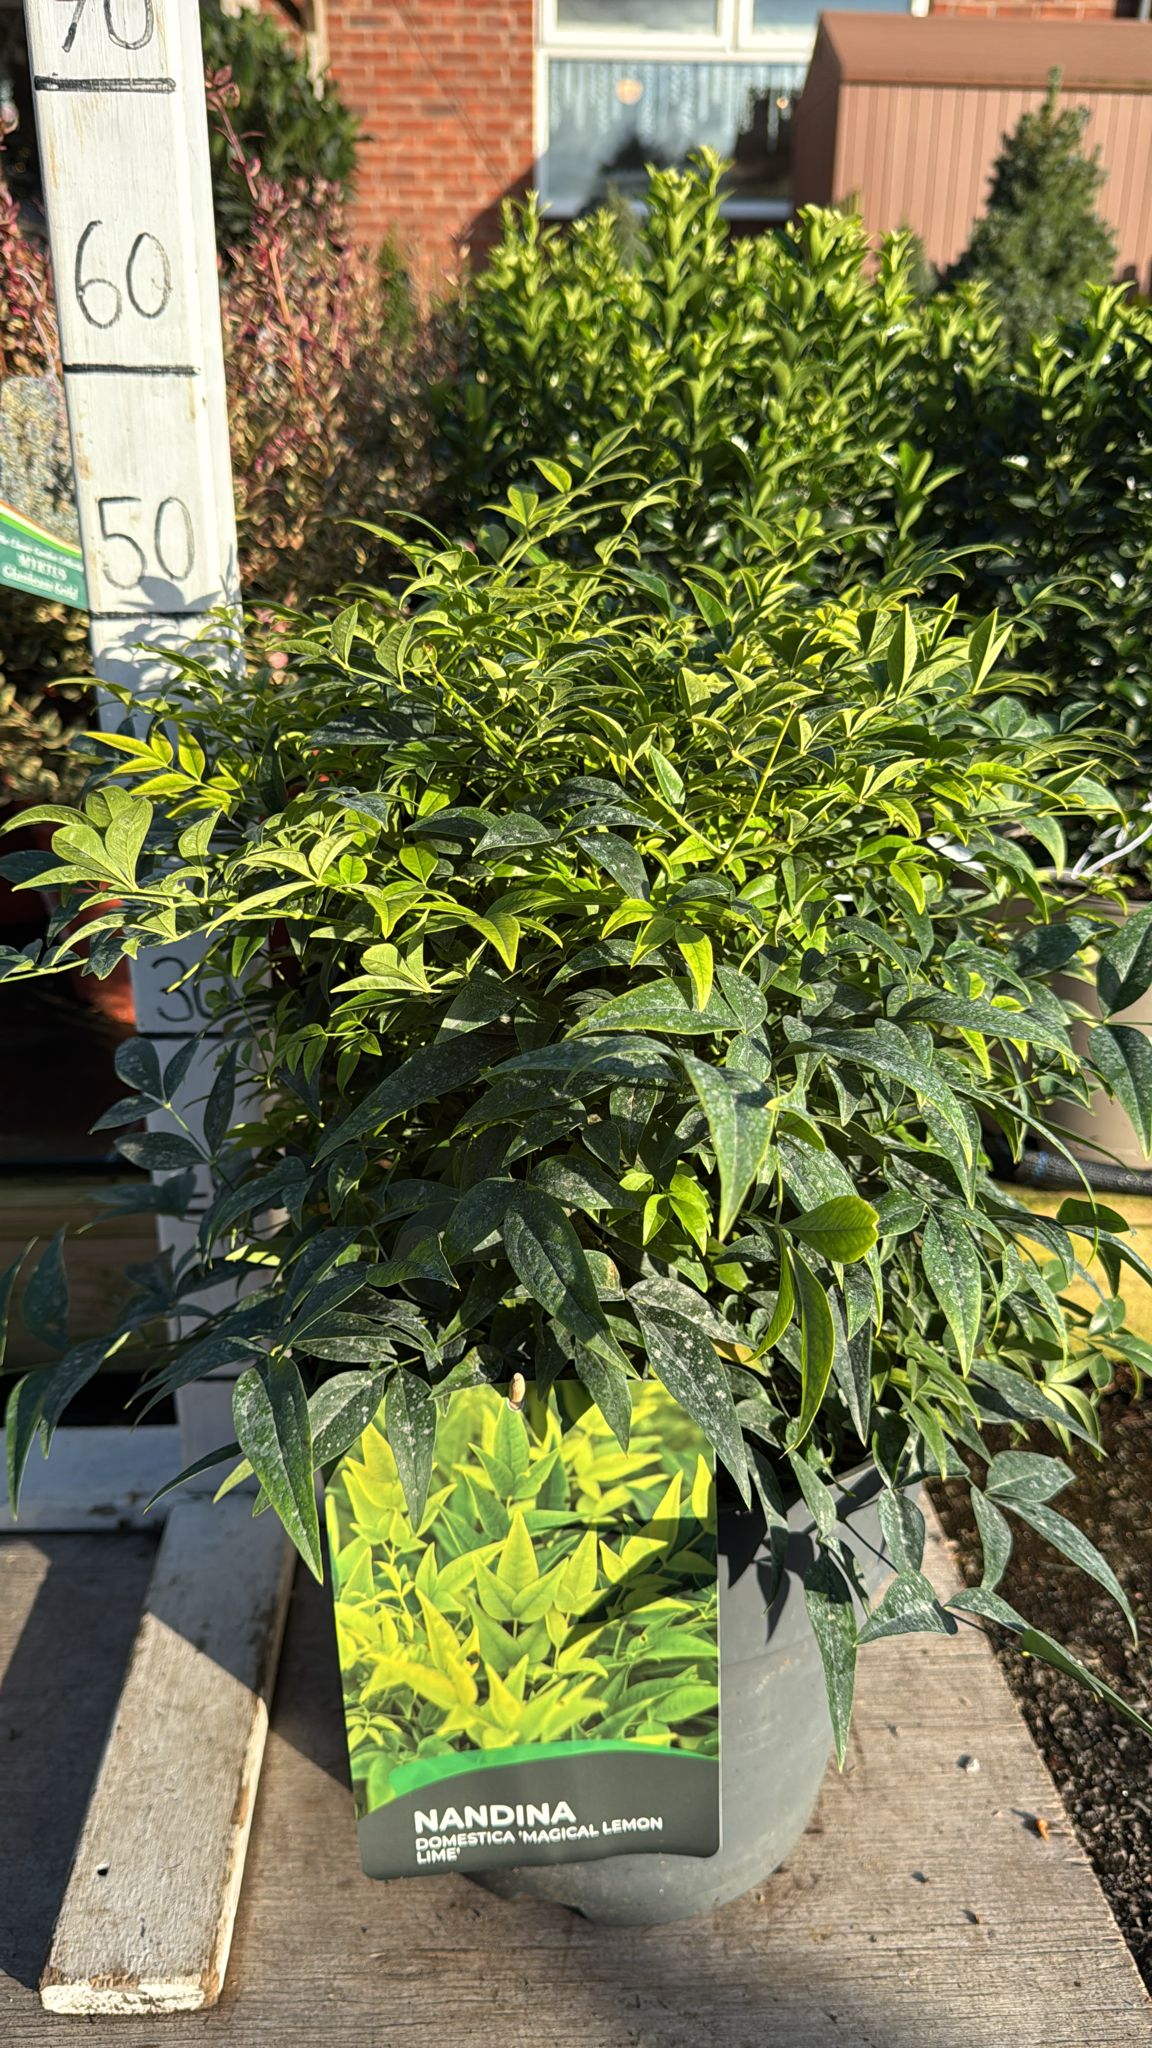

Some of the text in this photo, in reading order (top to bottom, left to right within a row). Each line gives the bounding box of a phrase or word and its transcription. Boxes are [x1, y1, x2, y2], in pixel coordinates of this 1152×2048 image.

[75, 220, 173, 329] 60
[97, 496, 195, 590] 50
[414, 1801, 577, 1834] NANDINA
[415, 1816, 663, 1852] DOMESTICA 'MAGICAL LEMON
[416, 1846, 461, 1866] LIME'
